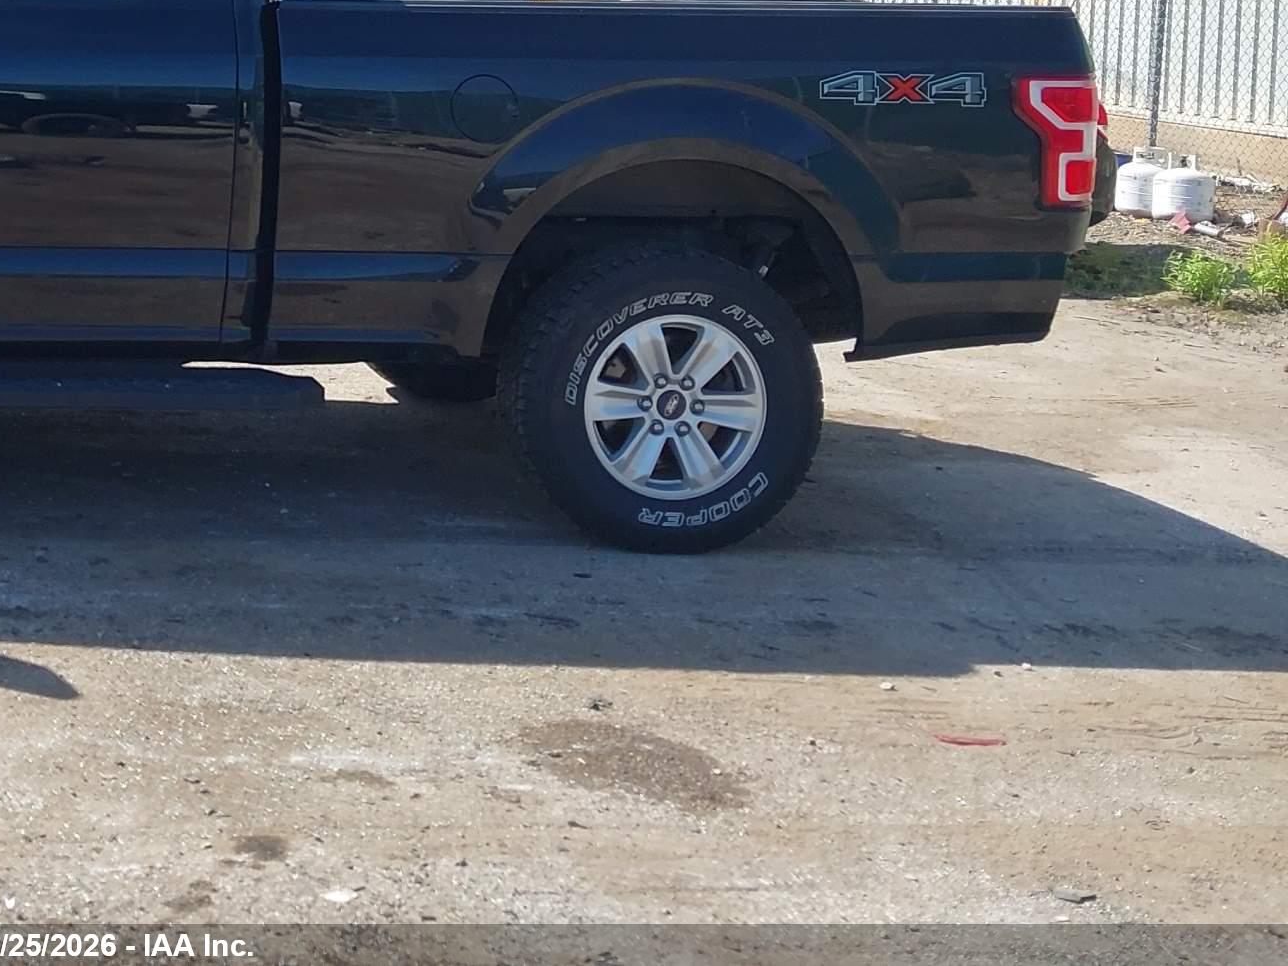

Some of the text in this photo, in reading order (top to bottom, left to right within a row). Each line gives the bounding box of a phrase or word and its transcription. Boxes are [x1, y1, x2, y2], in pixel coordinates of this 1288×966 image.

[565, 291, 776, 406] DISCOVERER AT3
[637, 471, 769, 527] COOPER
